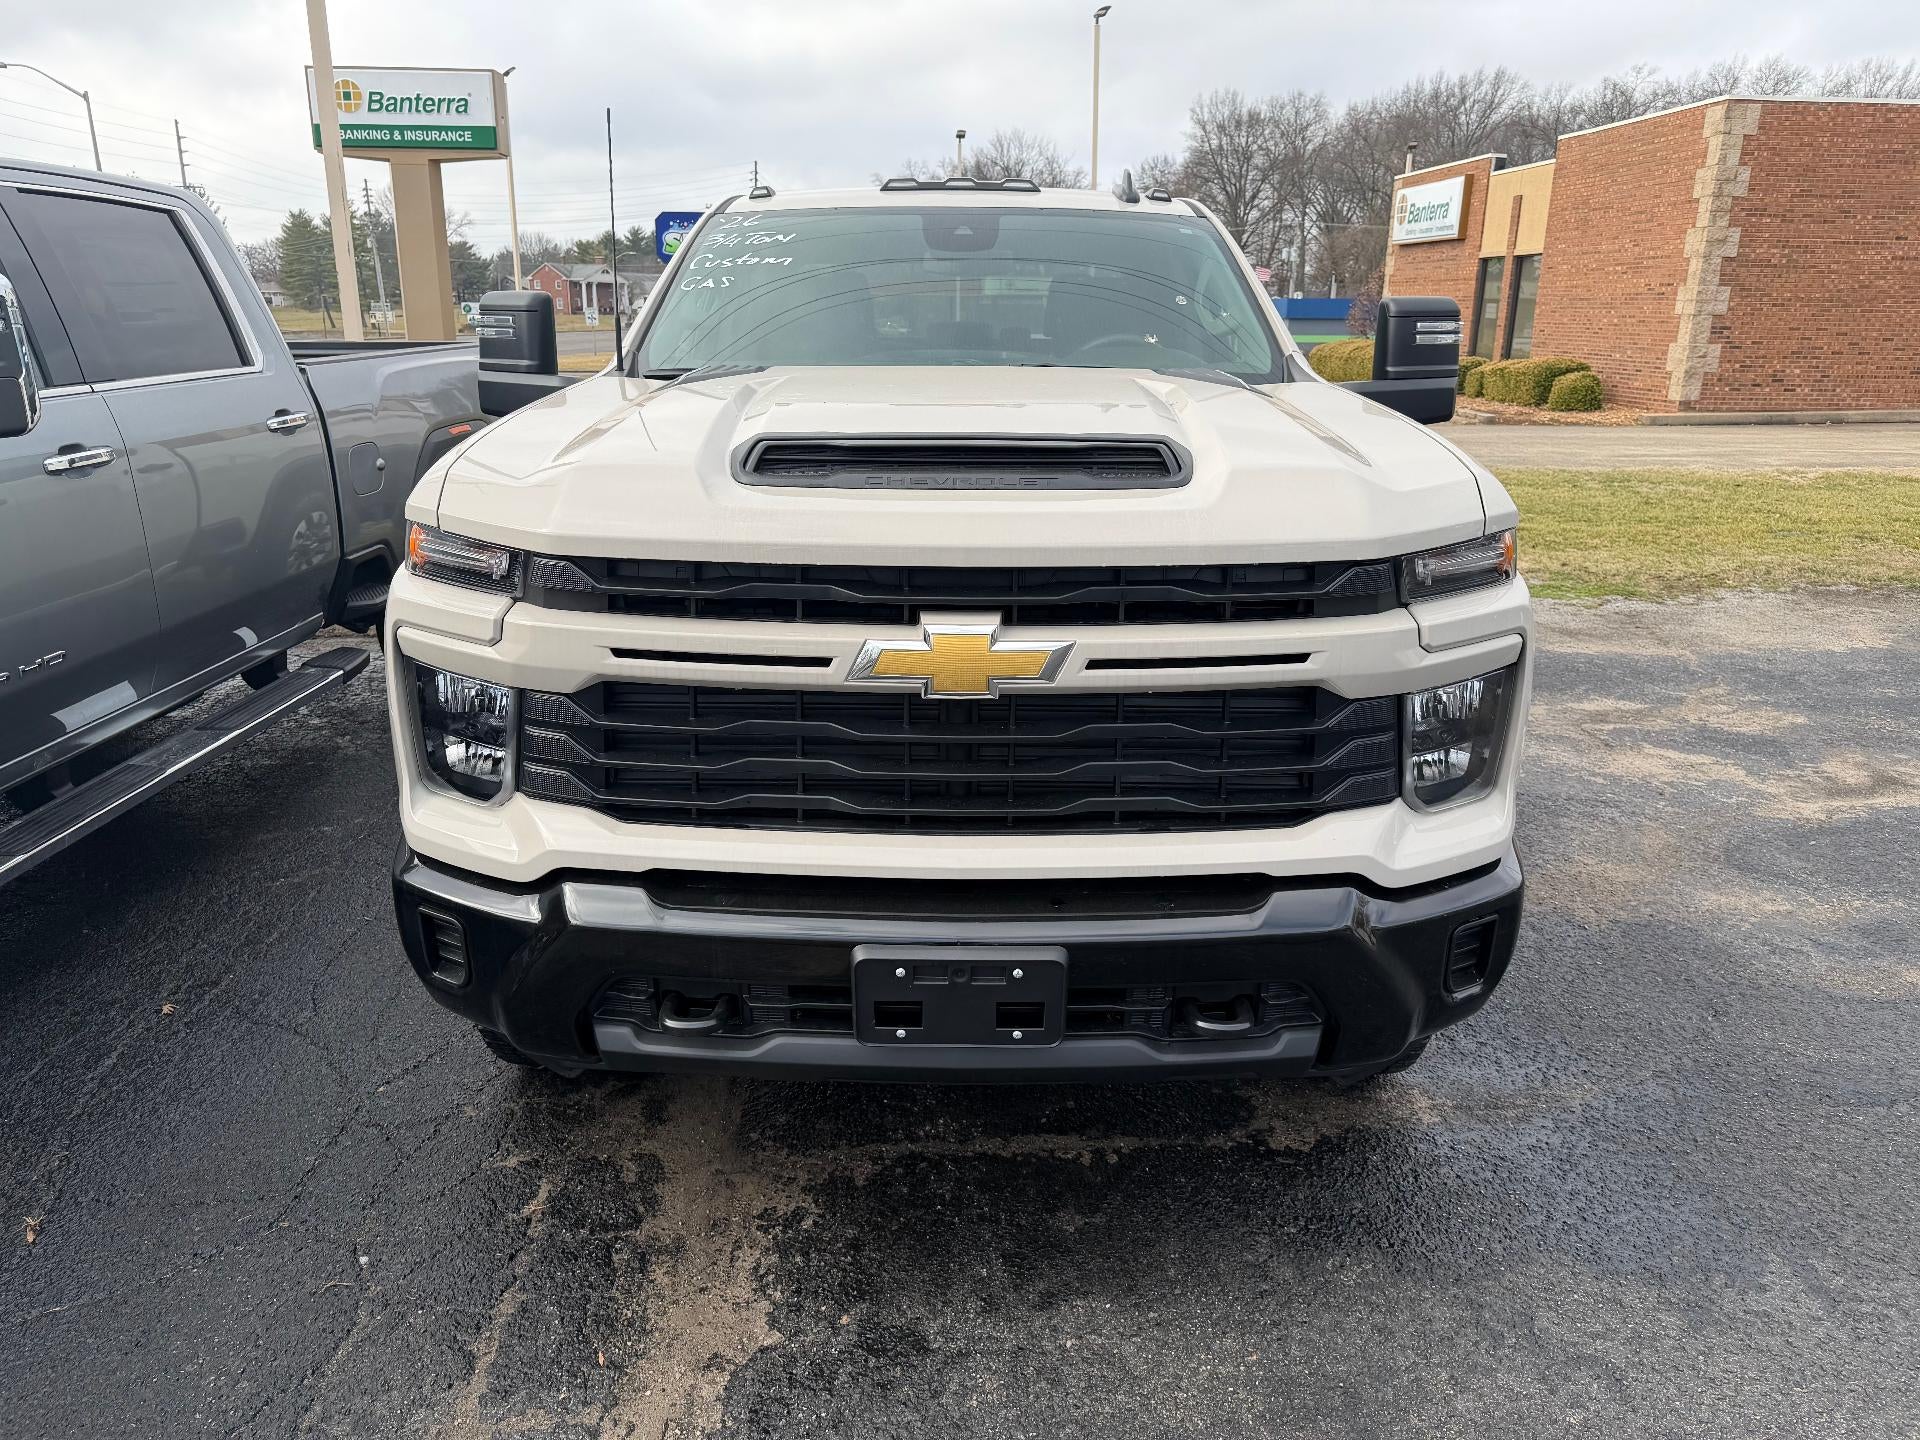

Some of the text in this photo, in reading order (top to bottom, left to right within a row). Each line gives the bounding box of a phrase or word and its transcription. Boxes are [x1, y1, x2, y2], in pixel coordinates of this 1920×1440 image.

[366, 90, 469, 113] Banterra
[338, 129, 473, 142] BANKING & INSURANCE
[1406, 200, 1450, 225] Banterra
[689, 252, 793, 270] Custom
[680, 276, 735, 291] GAS
[864, 476, 1060, 488] CHEVROLET
[18, 650, 66, 679] HD
